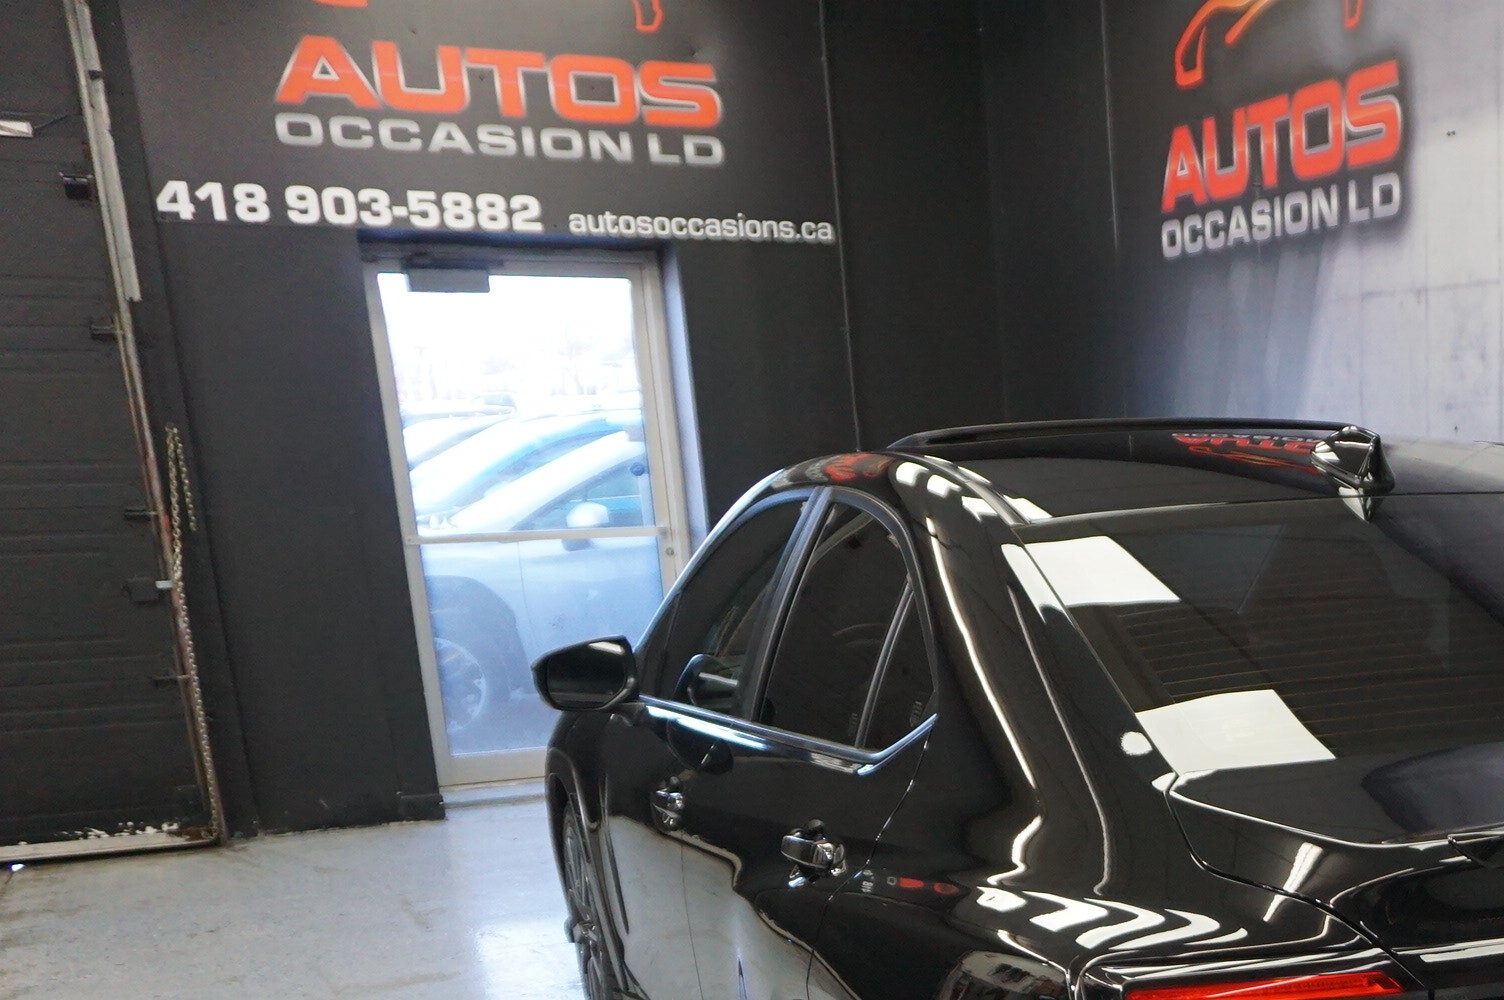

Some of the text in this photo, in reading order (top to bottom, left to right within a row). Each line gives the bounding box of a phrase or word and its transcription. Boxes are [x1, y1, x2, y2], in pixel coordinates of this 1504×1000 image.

[275, 35, 723, 129] AUTOS
[276, 112, 724, 166] OCCASION LD
[1161, 59, 1402, 213] AUTOS
[155, 180, 835, 243] 418 903-5882 autosoccasions.ca
[1161, 172, 1401, 261] OCCASION LD
